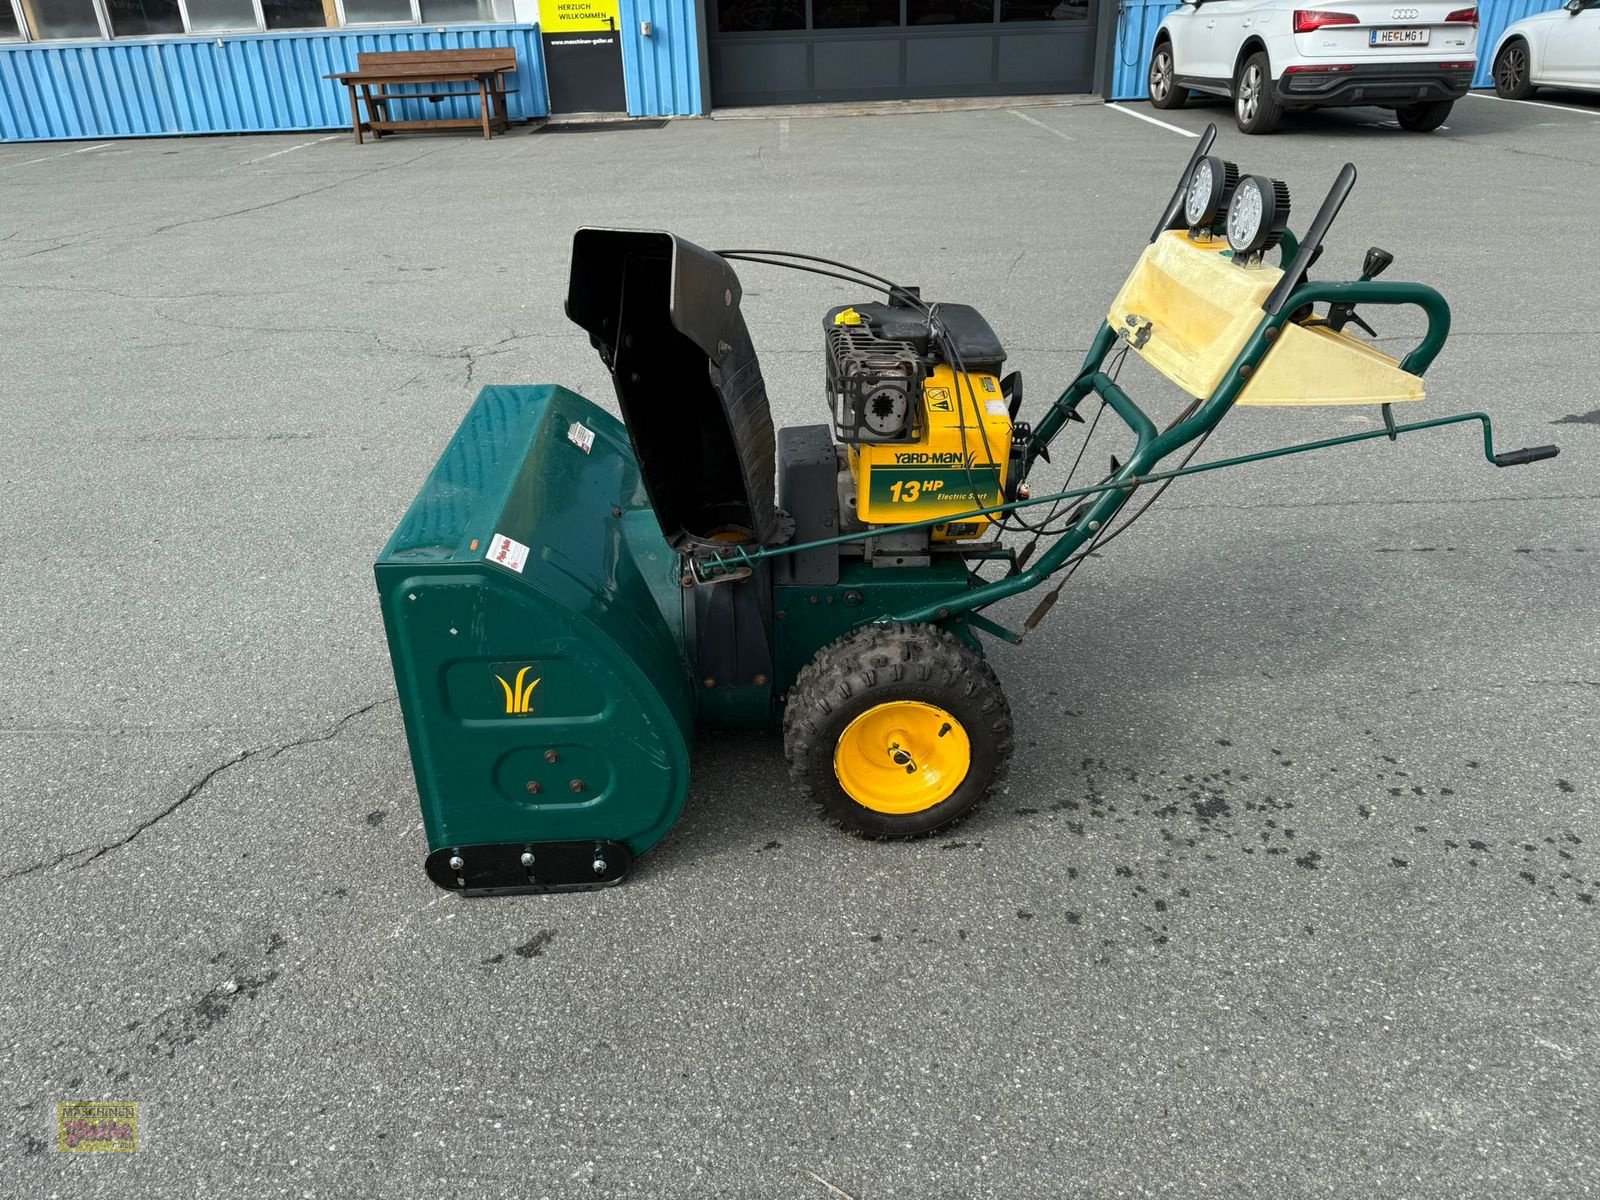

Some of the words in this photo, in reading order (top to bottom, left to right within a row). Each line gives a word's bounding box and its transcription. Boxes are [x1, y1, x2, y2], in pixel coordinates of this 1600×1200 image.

[559, 12, 606, 20] WILLKOMMEN
[1382, 31, 1393, 42] HE
[1400, 31, 1417, 41] LMG
[890, 480, 921, 503] 13
[922, 480, 944, 491] HP
